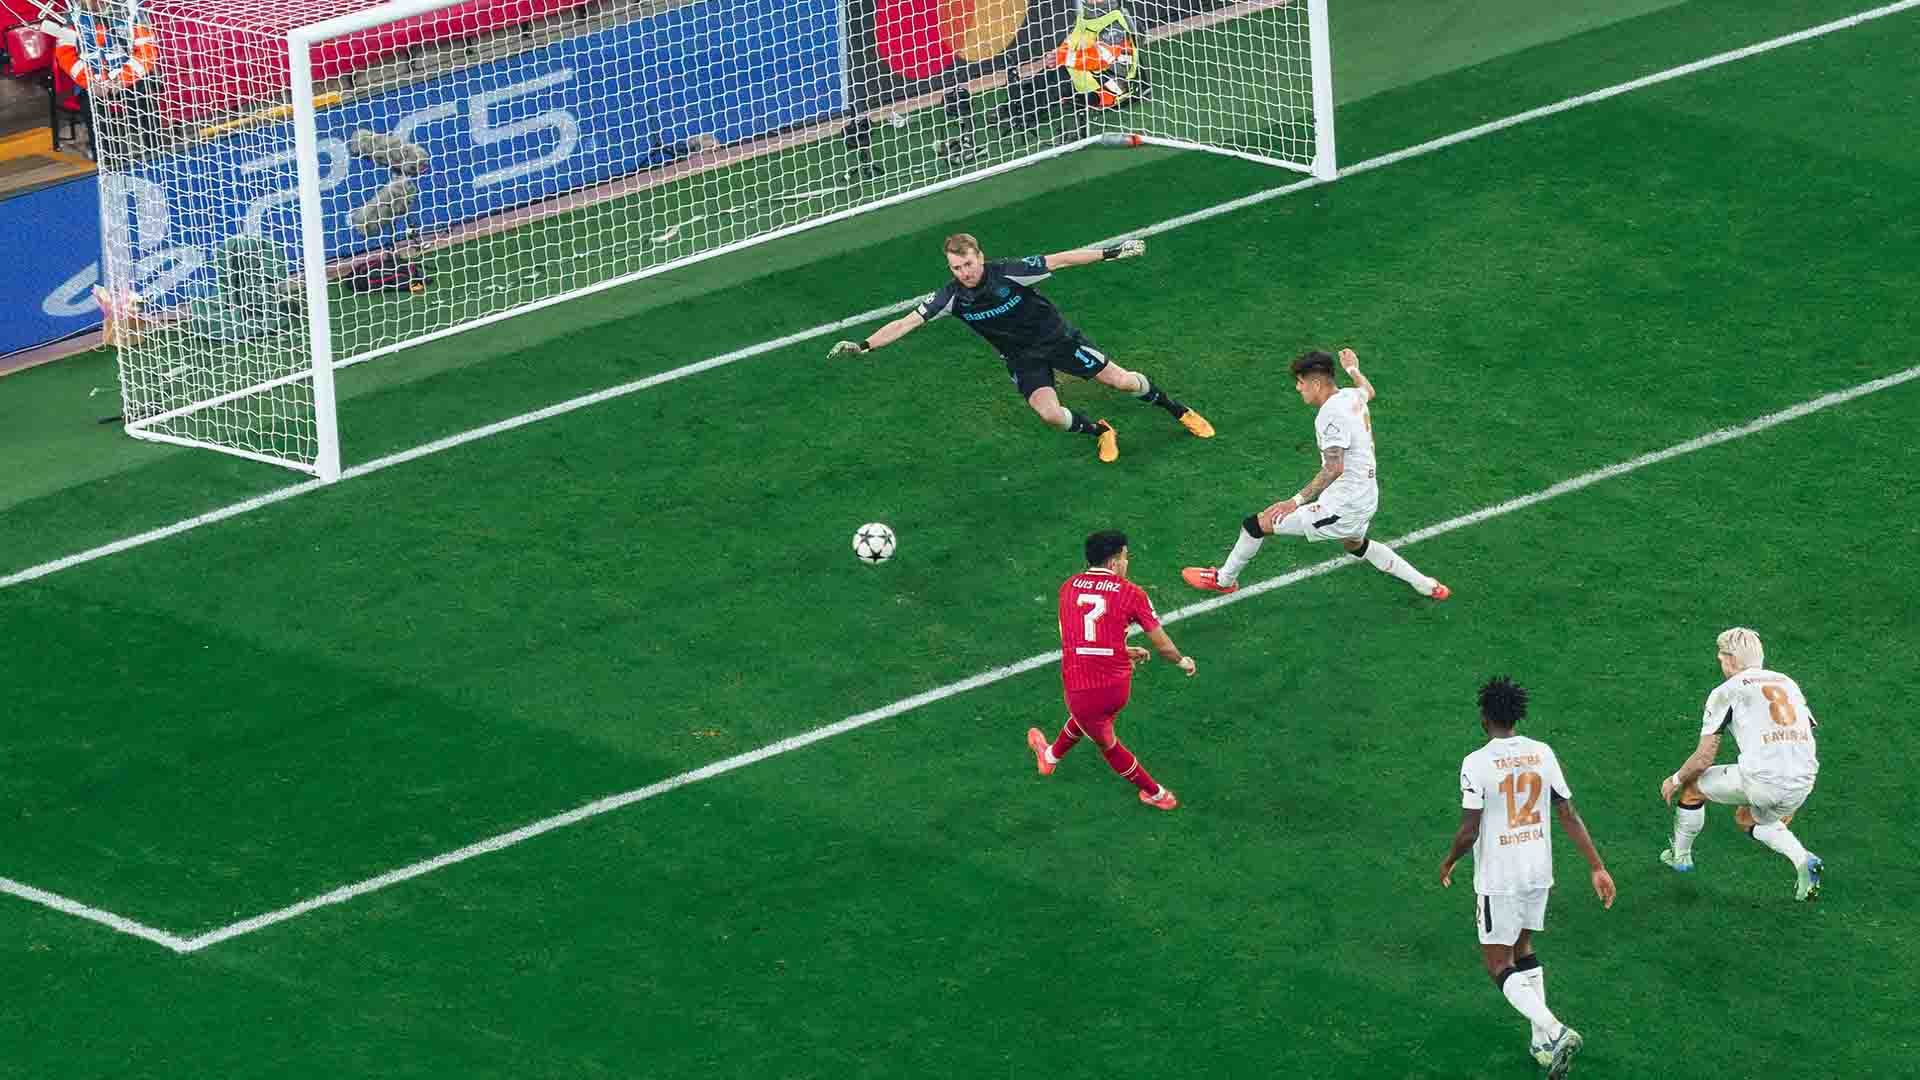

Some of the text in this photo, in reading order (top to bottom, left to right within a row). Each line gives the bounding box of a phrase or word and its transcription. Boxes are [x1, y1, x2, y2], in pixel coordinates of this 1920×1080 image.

[963, 295, 1022, 321] Barmenia
[1072, 578, 1121, 593] LUIS DÍAZ
[1077, 593, 1106, 642] 7
[1761, 686, 1797, 726] 8
[1499, 771, 1542, 829] 12
